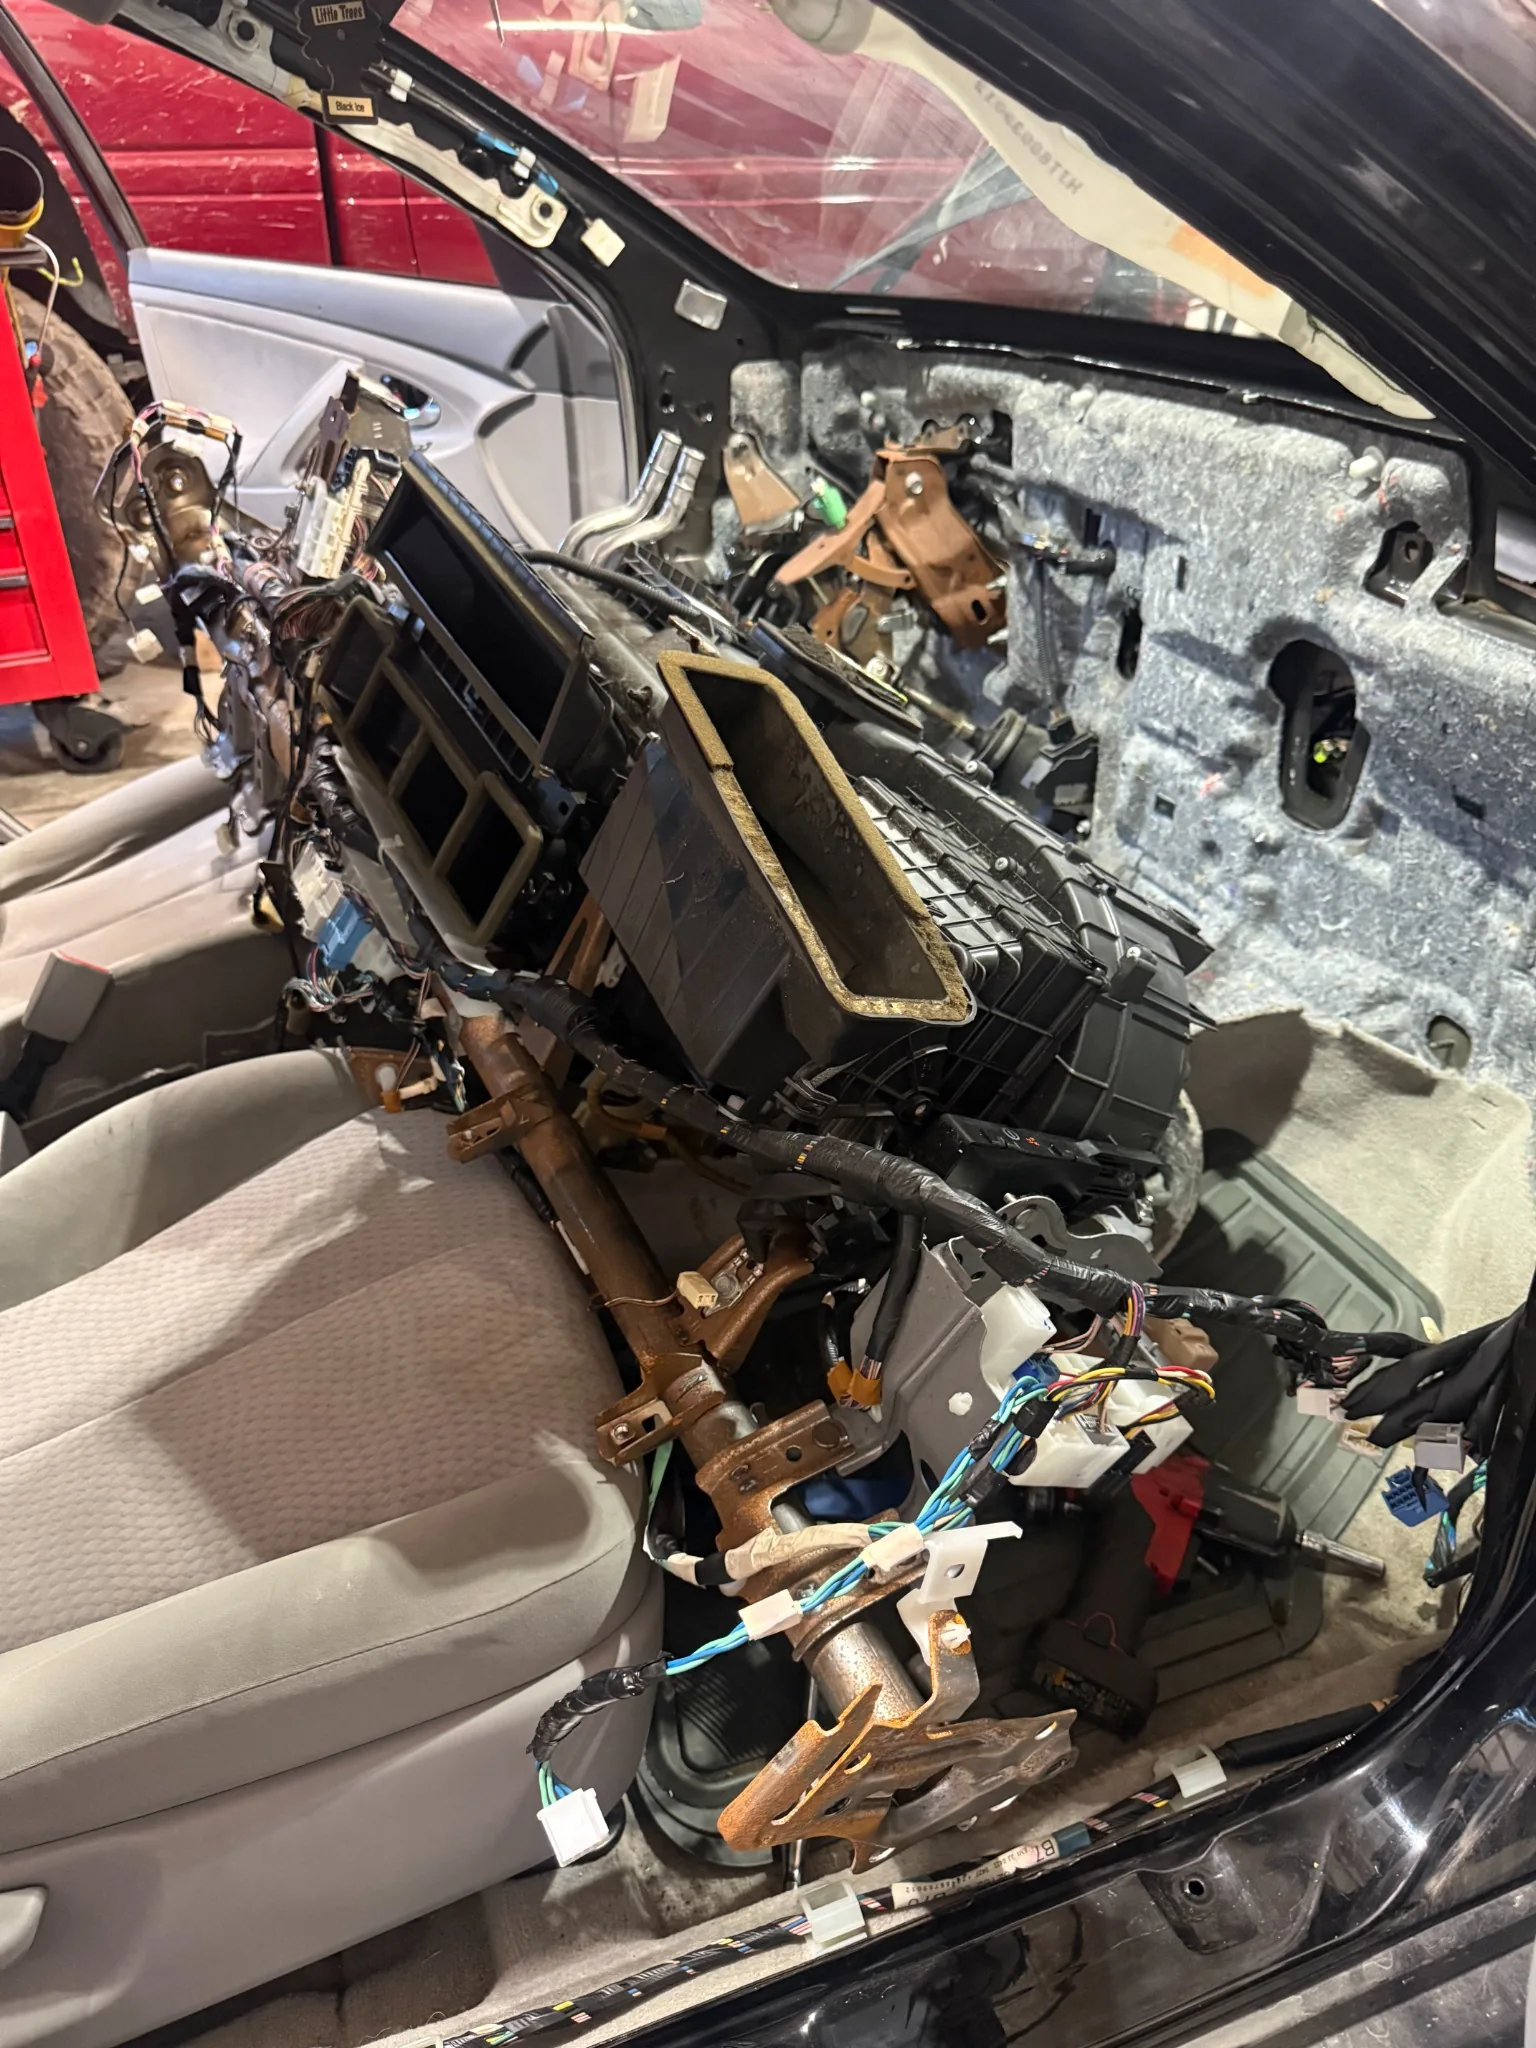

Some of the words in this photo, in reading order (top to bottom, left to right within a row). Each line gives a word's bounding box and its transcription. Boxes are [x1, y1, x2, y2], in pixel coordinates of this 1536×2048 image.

[315, 5, 338, 24] Little
[339, 4, 363, 21] Trees
[336, 101, 354, 111] Black
[355, 102, 365, 112] Ice
